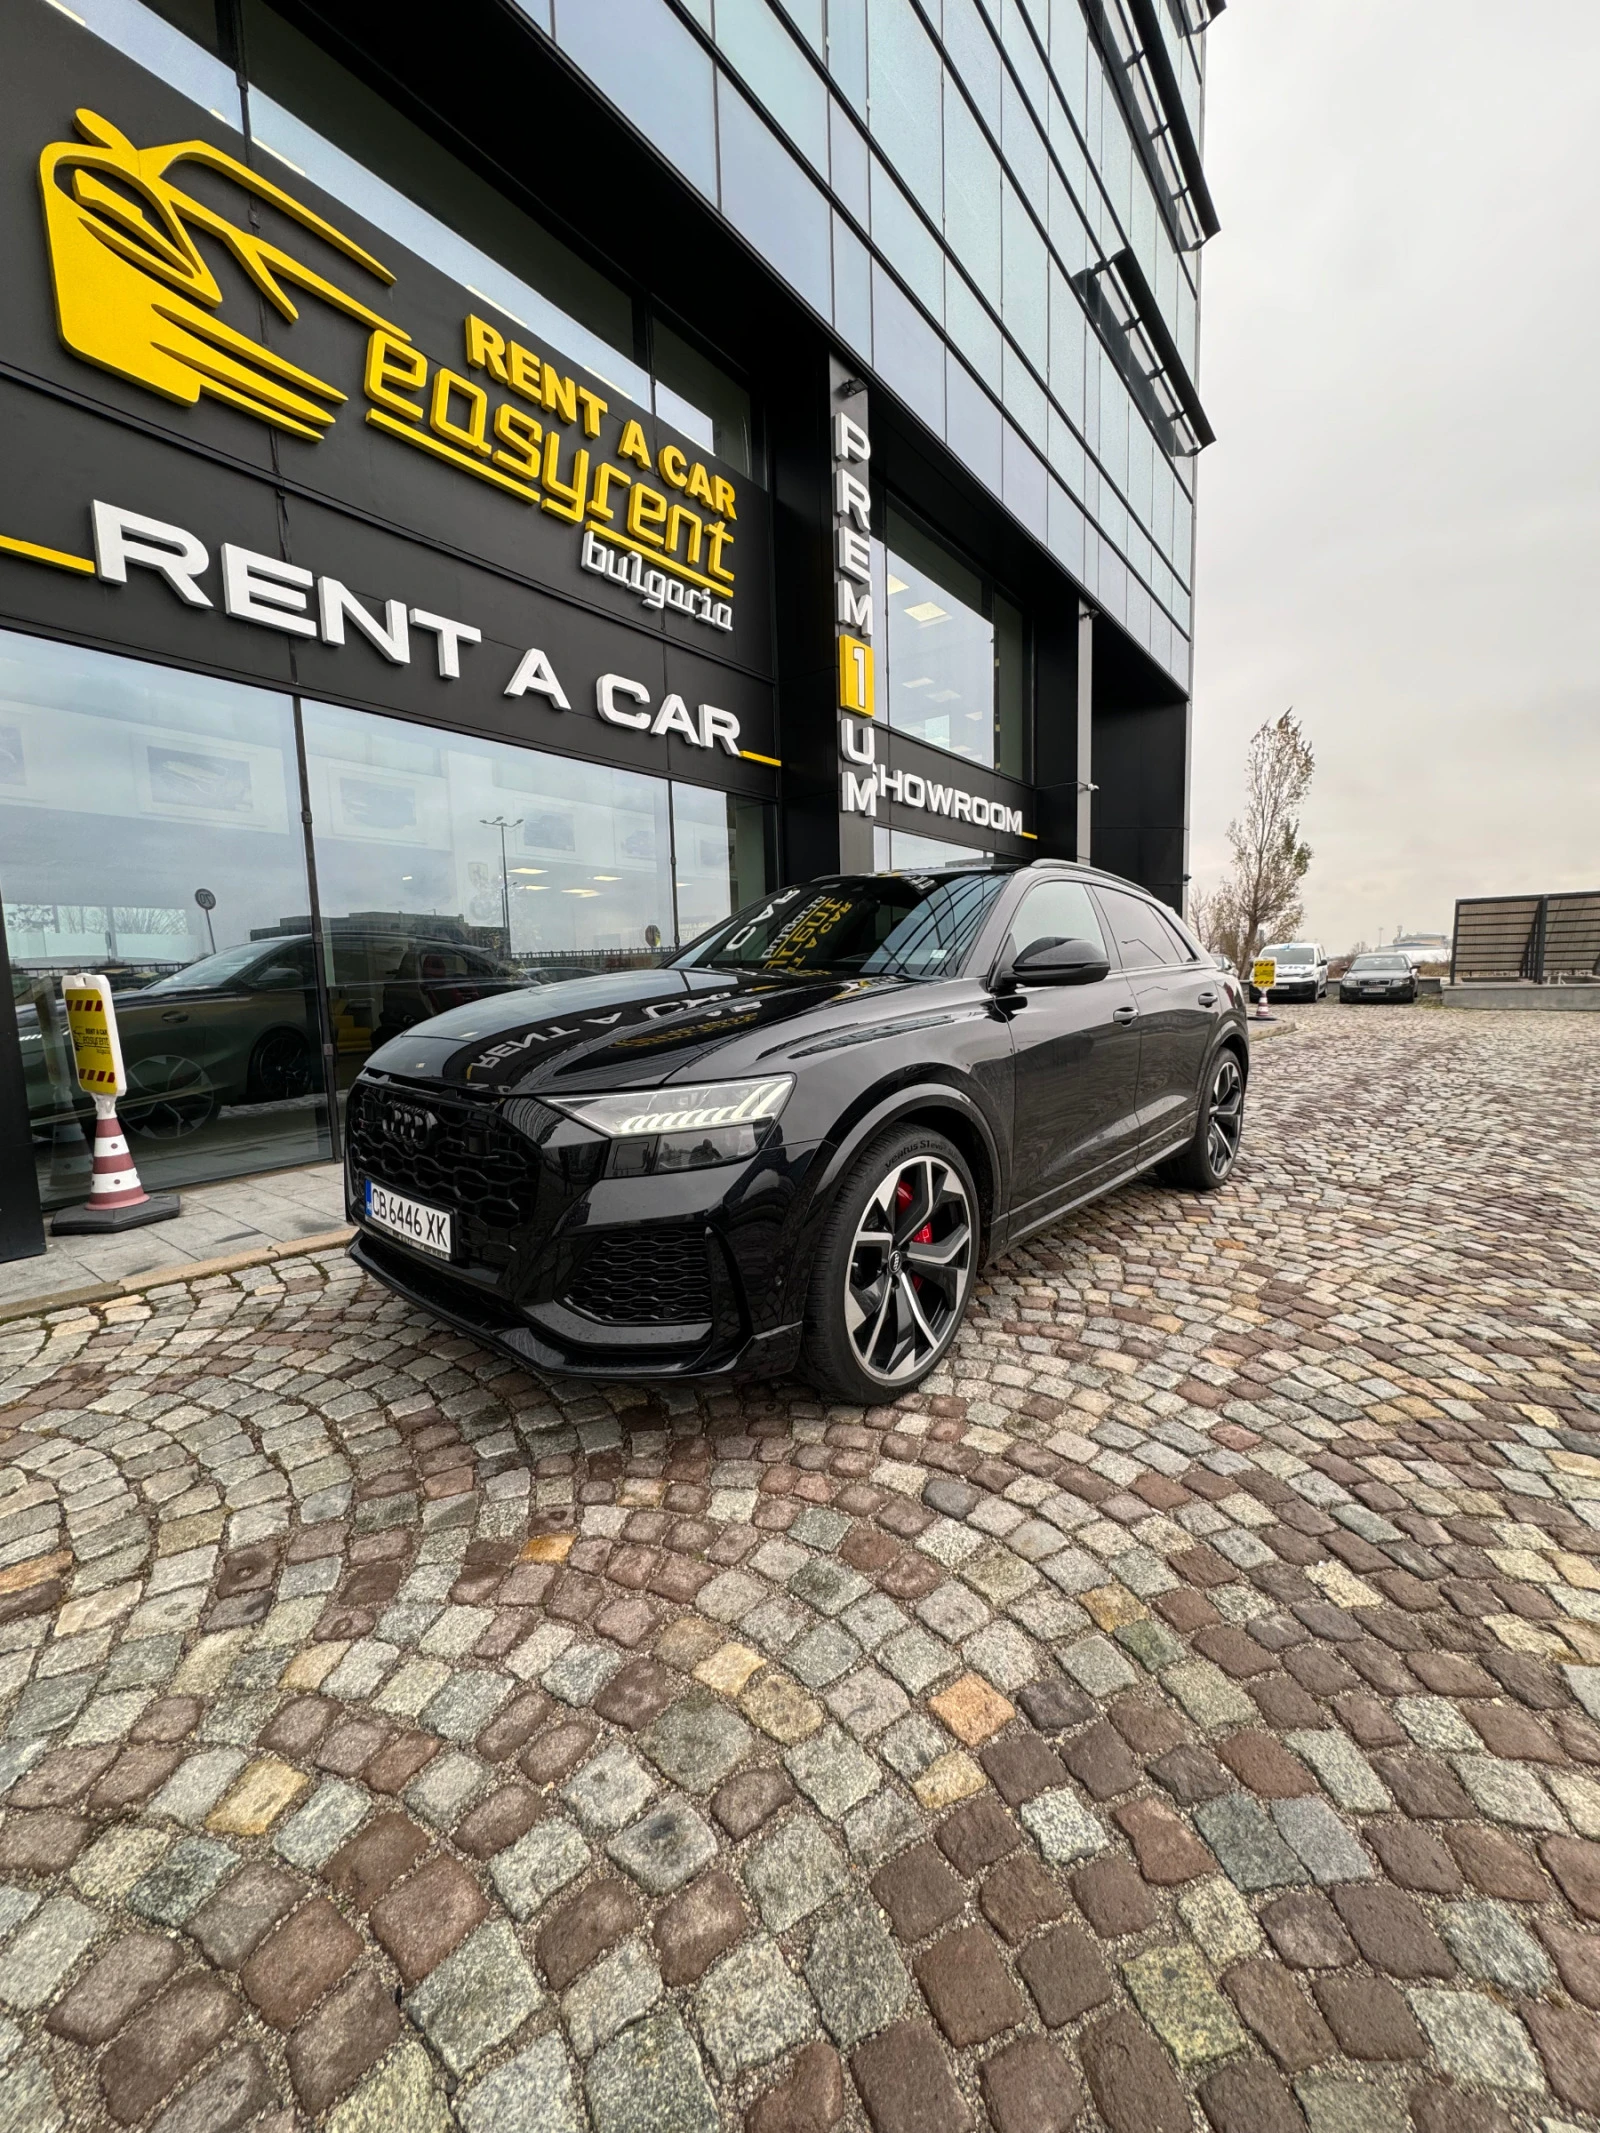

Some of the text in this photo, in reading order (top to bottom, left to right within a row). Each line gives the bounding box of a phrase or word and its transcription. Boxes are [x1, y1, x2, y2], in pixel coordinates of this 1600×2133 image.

[363, 329, 735, 583] easyrent
[465, 313, 737, 520] RENT A CAR
[92, 499, 742, 757] RENT A CAR
[581, 530, 733, 631] bulgaria
[872, 763, 1023, 836] HOWROOM
[372, 1188, 447, 1249] CB 6446 XK
